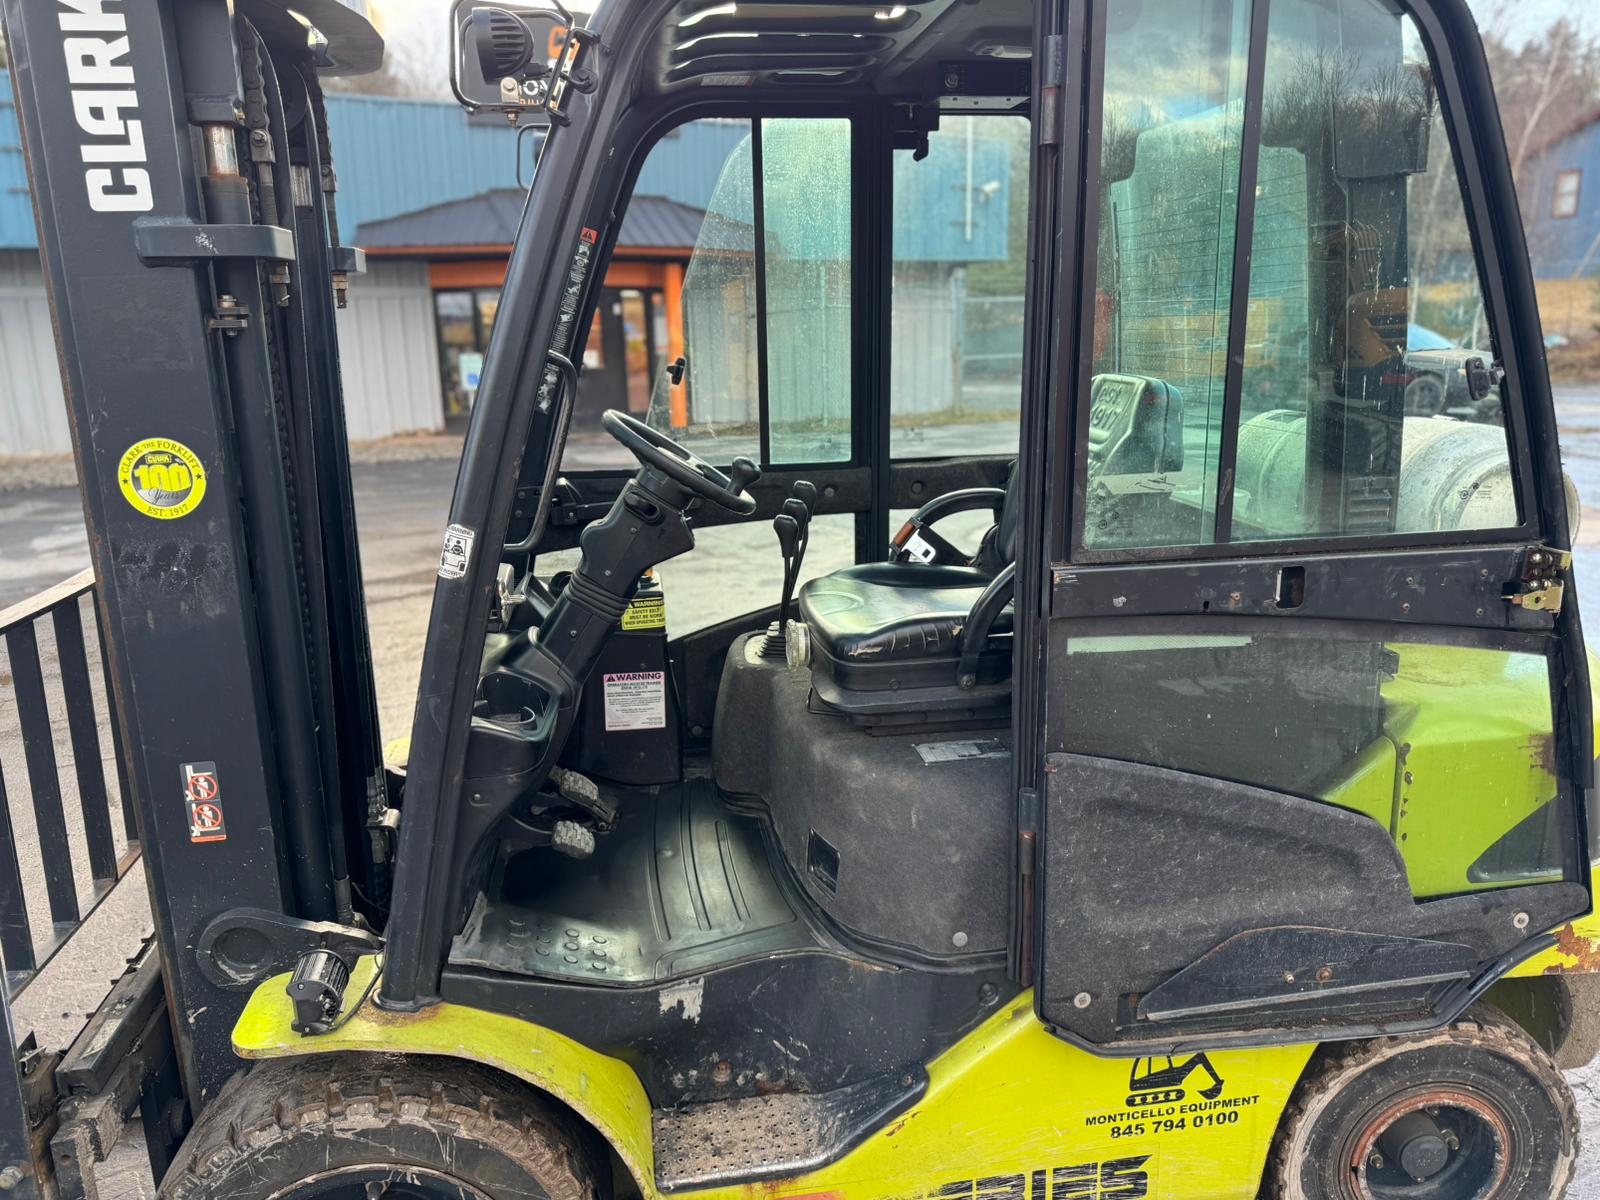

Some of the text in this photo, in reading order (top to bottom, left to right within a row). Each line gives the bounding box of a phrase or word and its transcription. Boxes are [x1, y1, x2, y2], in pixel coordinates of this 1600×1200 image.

[58, 0, 153, 212] CLARK
[1091, 406, 1122, 430] 1917
[121, 446, 142, 473] CLARK
[157, 440, 200, 471] FORKLIFT
[134, 463, 192, 492] 100
[148, 486, 181, 504] Years
[147, 504, 188, 517] EST. 1917
[616, 672, 662, 680] WARNING
[1086, 1094, 1261, 1127] MONTICELLO EQUIPMENT
[1110, 1110, 1239, 1140] 845 794 0100
[915, 1154, 1153, 1200] RIES
